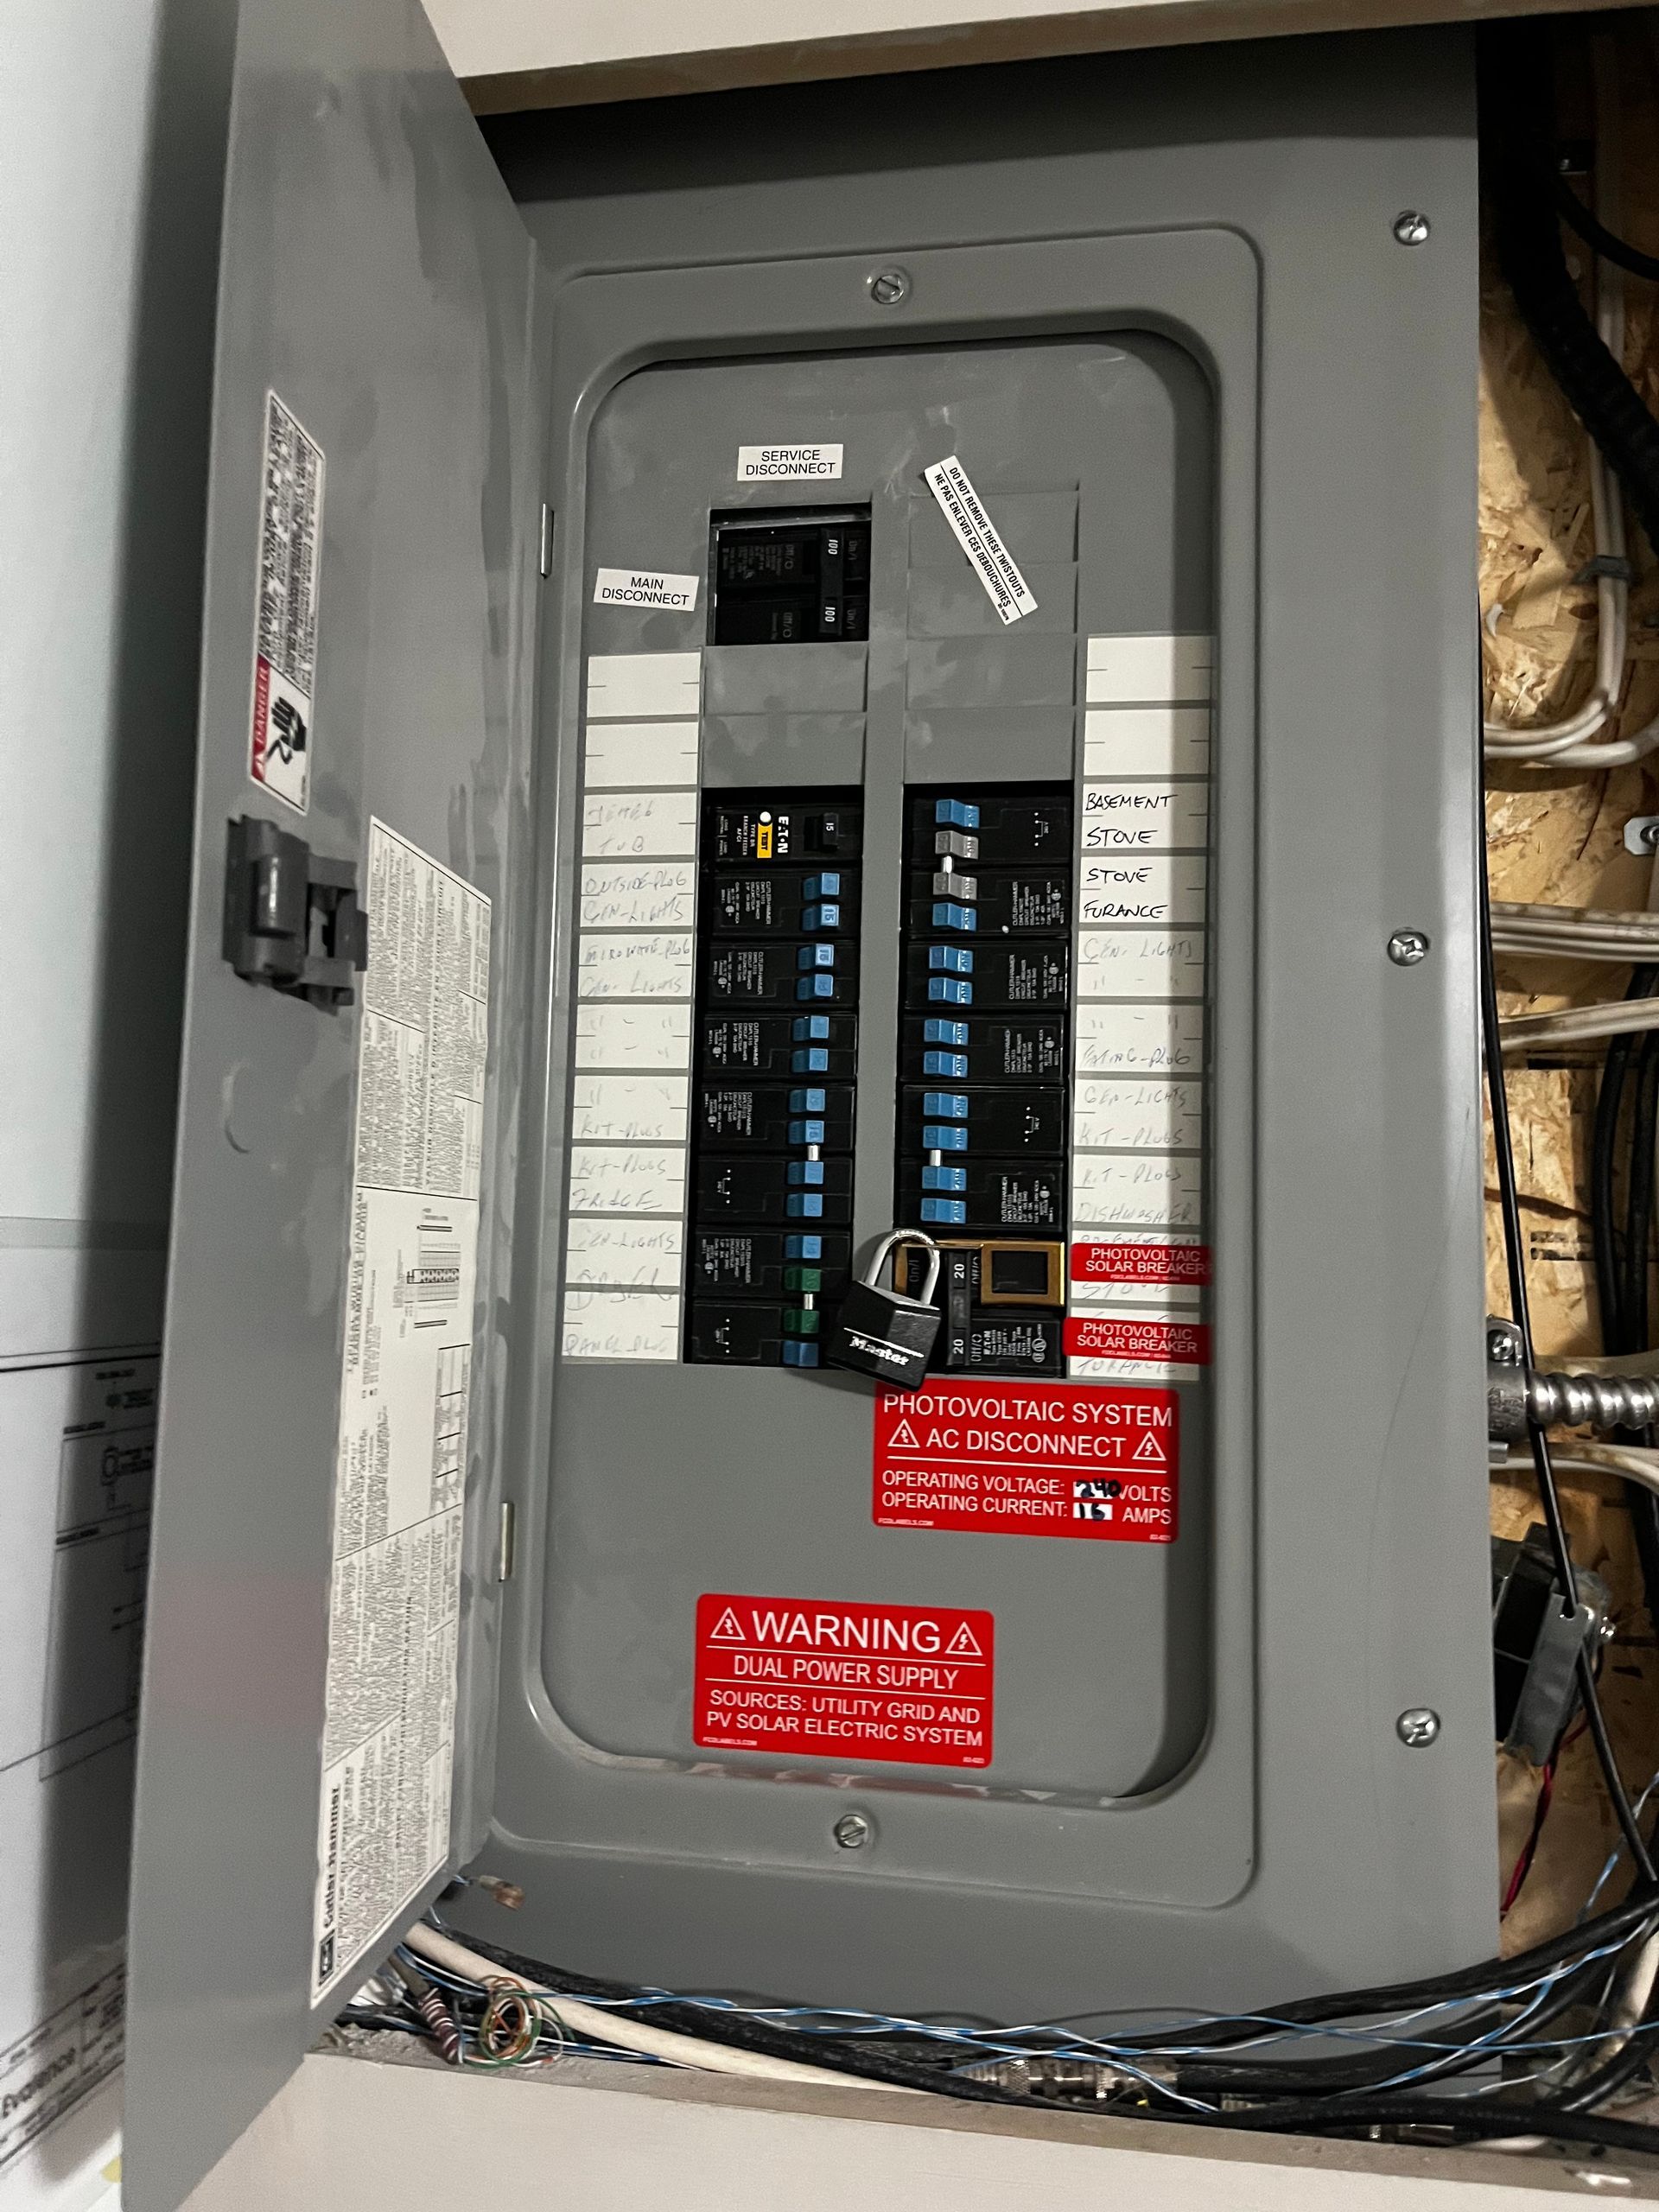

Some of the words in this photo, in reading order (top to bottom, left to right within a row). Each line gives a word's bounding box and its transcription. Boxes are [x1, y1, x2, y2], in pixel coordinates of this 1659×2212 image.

[761, 449, 820, 462] SERVICE
[746, 461, 836, 476] DISCONNECT
[935, 474, 945, 486] NE
[940, 485, 953, 501] PAS
[949, 501, 972, 537] ENLEVER
[968, 537, 981, 552] CES
[976, 552, 1011, 607] DEBOUCHURES
[950, 467, 960, 480] DO
[957, 480, 969, 496] NOT
[965, 496, 988, 530] REMOVE
[983, 529, 1001, 554] THESE
[996, 553, 1025, 597] TWISTOUTS
[828, 539, 838, 555] 100
[631, 576, 664, 591] MAIN
[601, 587, 690, 606] DISCONNECT
[824, 607, 836, 622] 100
[256, 666, 268, 745] DANGER
[1085, 792, 1178, 811] BASEMENT
[826, 823, 834, 831] 15
[1086, 827, 1159, 847] STOVE
[1086, 868, 1153, 883] STOVE
[1083, 899, 1169, 918] FURANCE
[1091, 1248, 1201, 1262] PHOTOVOLTAIC
[954, 1263, 964, 1279] 20
[1085, 1261, 1134, 1272] SOLAR
[1137, 1263, 1207, 1274] BREAKER
[1083, 1322, 1192, 1339] PHOTOVOLTAIC
[849, 1335, 910, 1366] Master
[953, 1339, 963, 1354] 20
[1077, 1335, 1125, 1349] SOLAR
[1128, 1338, 1198, 1352] BREAKER
[883, 1394, 1065, 1422] PHOTOVOLTAIC
[1071, 1402, 1173, 1427] SYSTEM
[925, 1427, 960, 1449] AC
[967, 1429, 1127, 1458] DISCONNECT
[882, 1470, 979, 1491] OPERATING
[982, 1475, 1065, 1495] VOLTAGE:
[1075, 1478, 1122, 1497] 240
[1118, 1484, 1172, 1503] VOLTS
[882, 1491, 978, 1512] OPERATING
[982, 1497, 1068, 1518] CURRENT:
[1122, 1507, 1172, 1525] AMPS
[752, 1609, 941, 1654] WARNING
[734, 1655, 788, 1679] DUAL
[793, 1659, 871, 1685] POWER
[876, 1664, 959, 1690] SUPPLY
[709, 1689, 807, 1713] SOURCES:
[812, 1697, 883, 1717] UTILITY
[887, 1701, 936, 1721] GRID
[938, 1706, 980, 1724] AND
[706, 1711, 732, 1728] PV
[736, 1713, 800, 1733] SOLAR
[804, 1718, 899, 1740] ELECTRIC
[903, 1724, 982, 1747] SYSTEM
